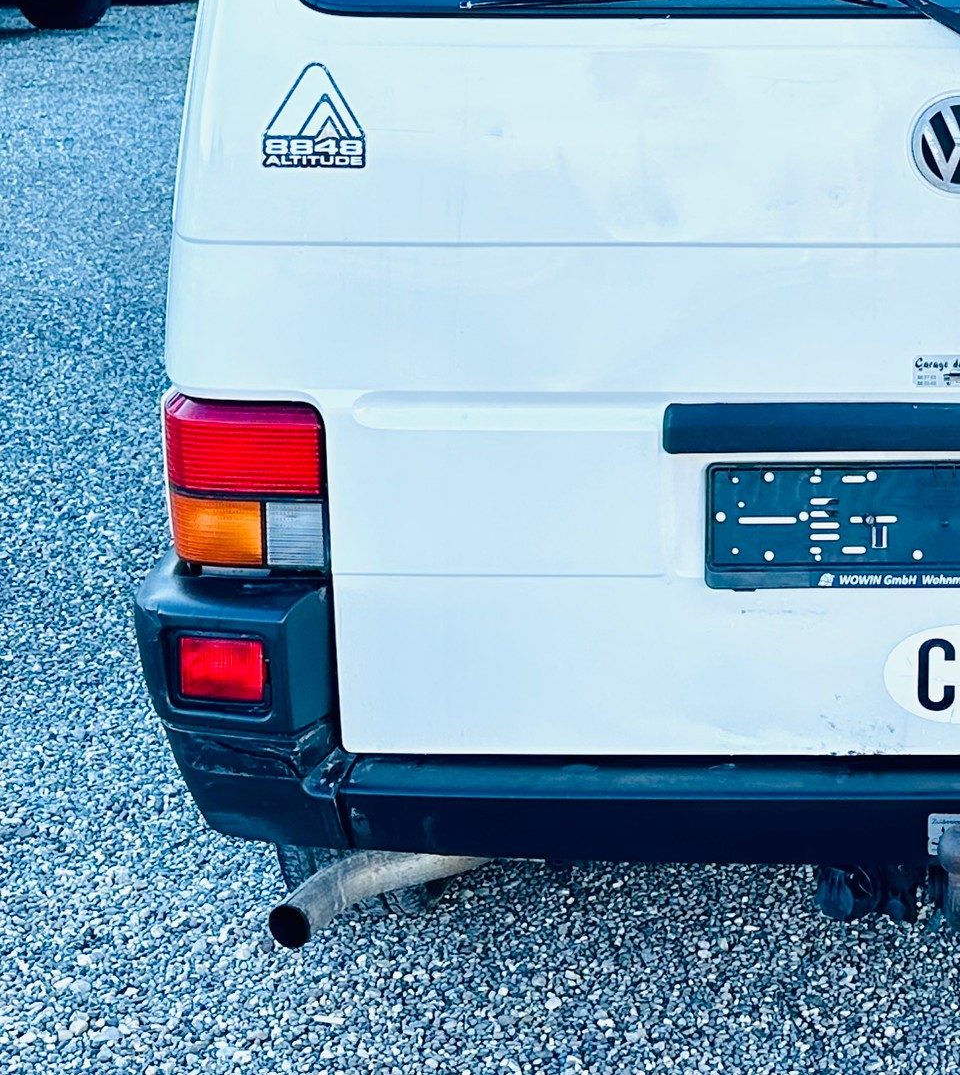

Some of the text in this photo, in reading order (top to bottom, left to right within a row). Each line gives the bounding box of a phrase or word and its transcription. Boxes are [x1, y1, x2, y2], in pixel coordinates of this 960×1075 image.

[265, 138, 363, 155] 8848
[265, 155, 363, 166] ALTITUDE
[915, 357, 948, 371] Garage
[839, 575, 882, 585] WOWIN
[884, 575, 916, 585] GmbH
